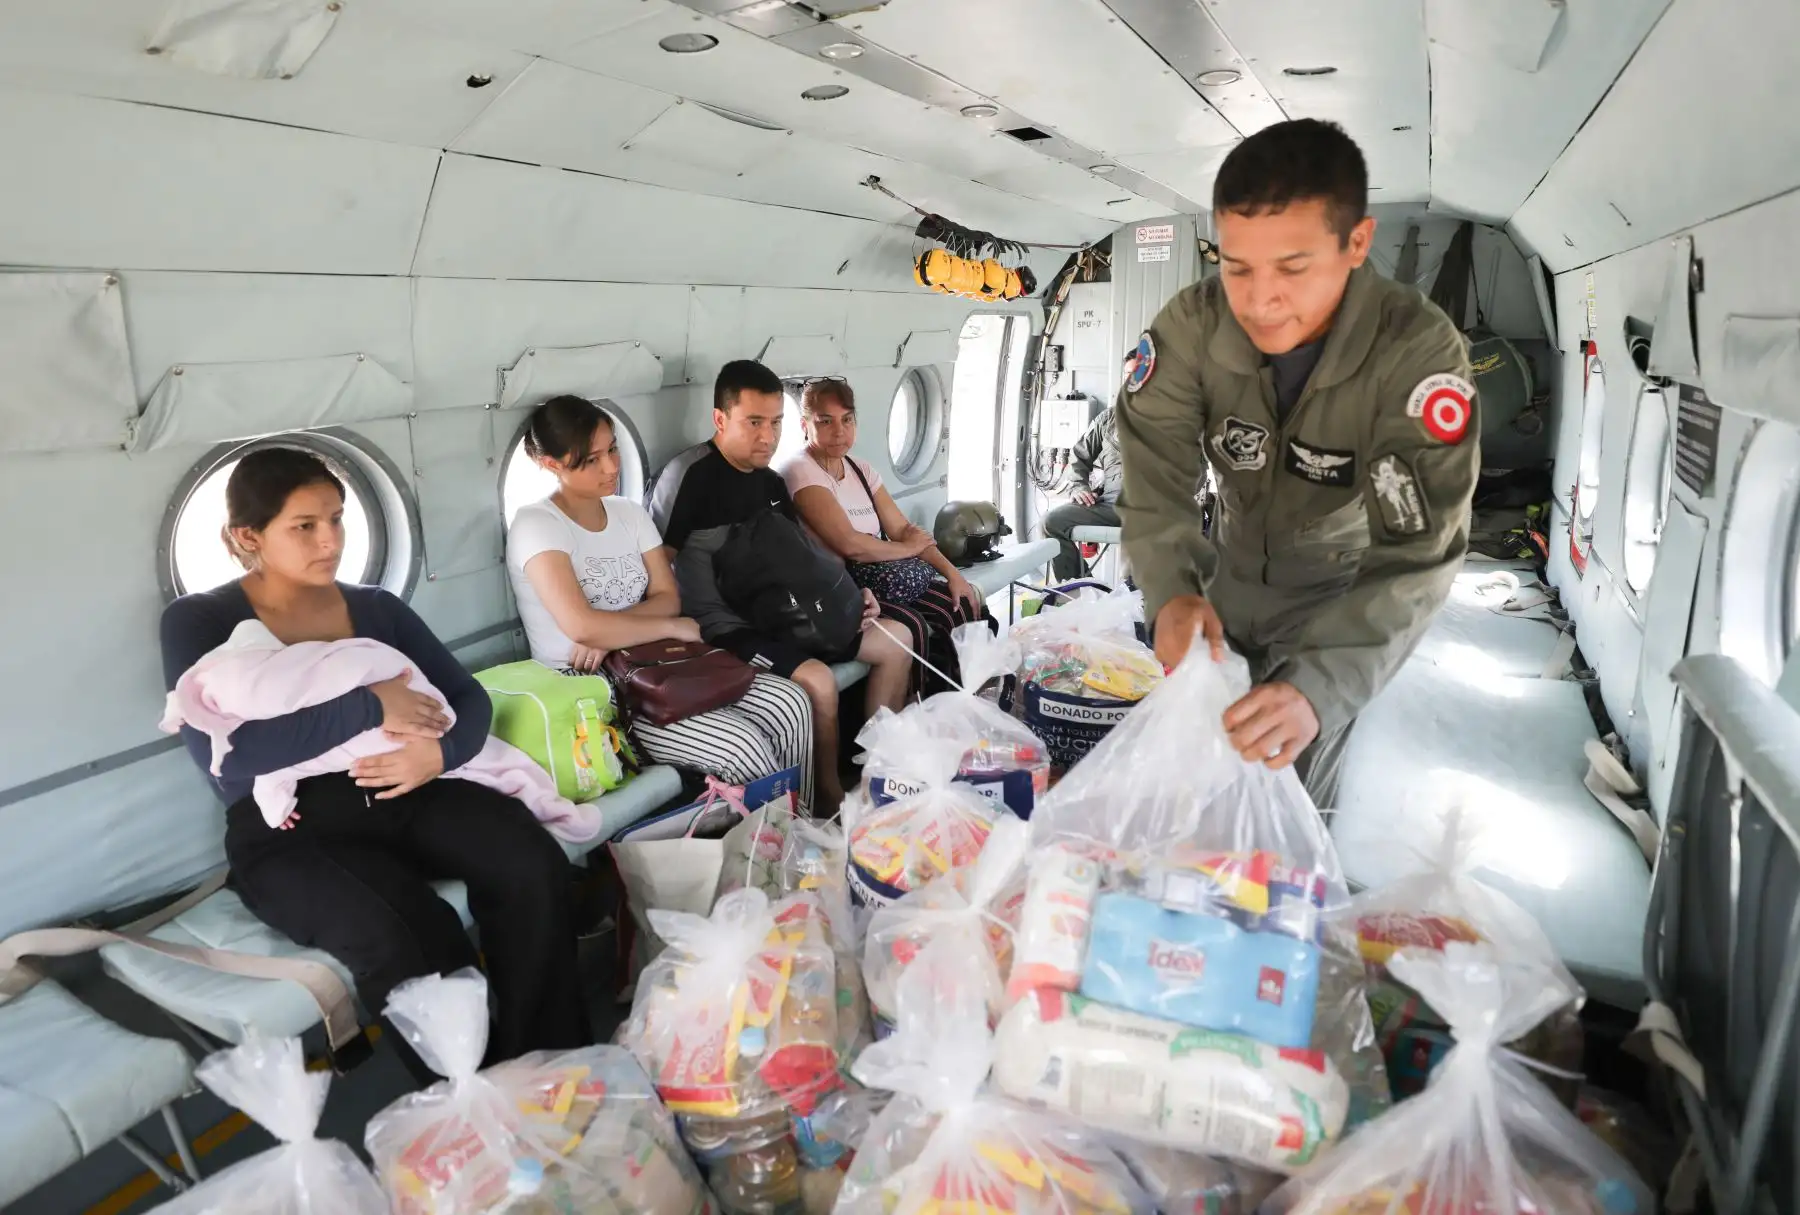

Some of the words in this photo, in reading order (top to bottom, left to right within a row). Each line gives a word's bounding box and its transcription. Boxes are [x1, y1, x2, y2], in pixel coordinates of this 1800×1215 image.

[1295, 461, 1339, 478] ACOSTA
[1043, 702, 1102, 720] DONADO
[1107, 711, 1127, 721] PO
